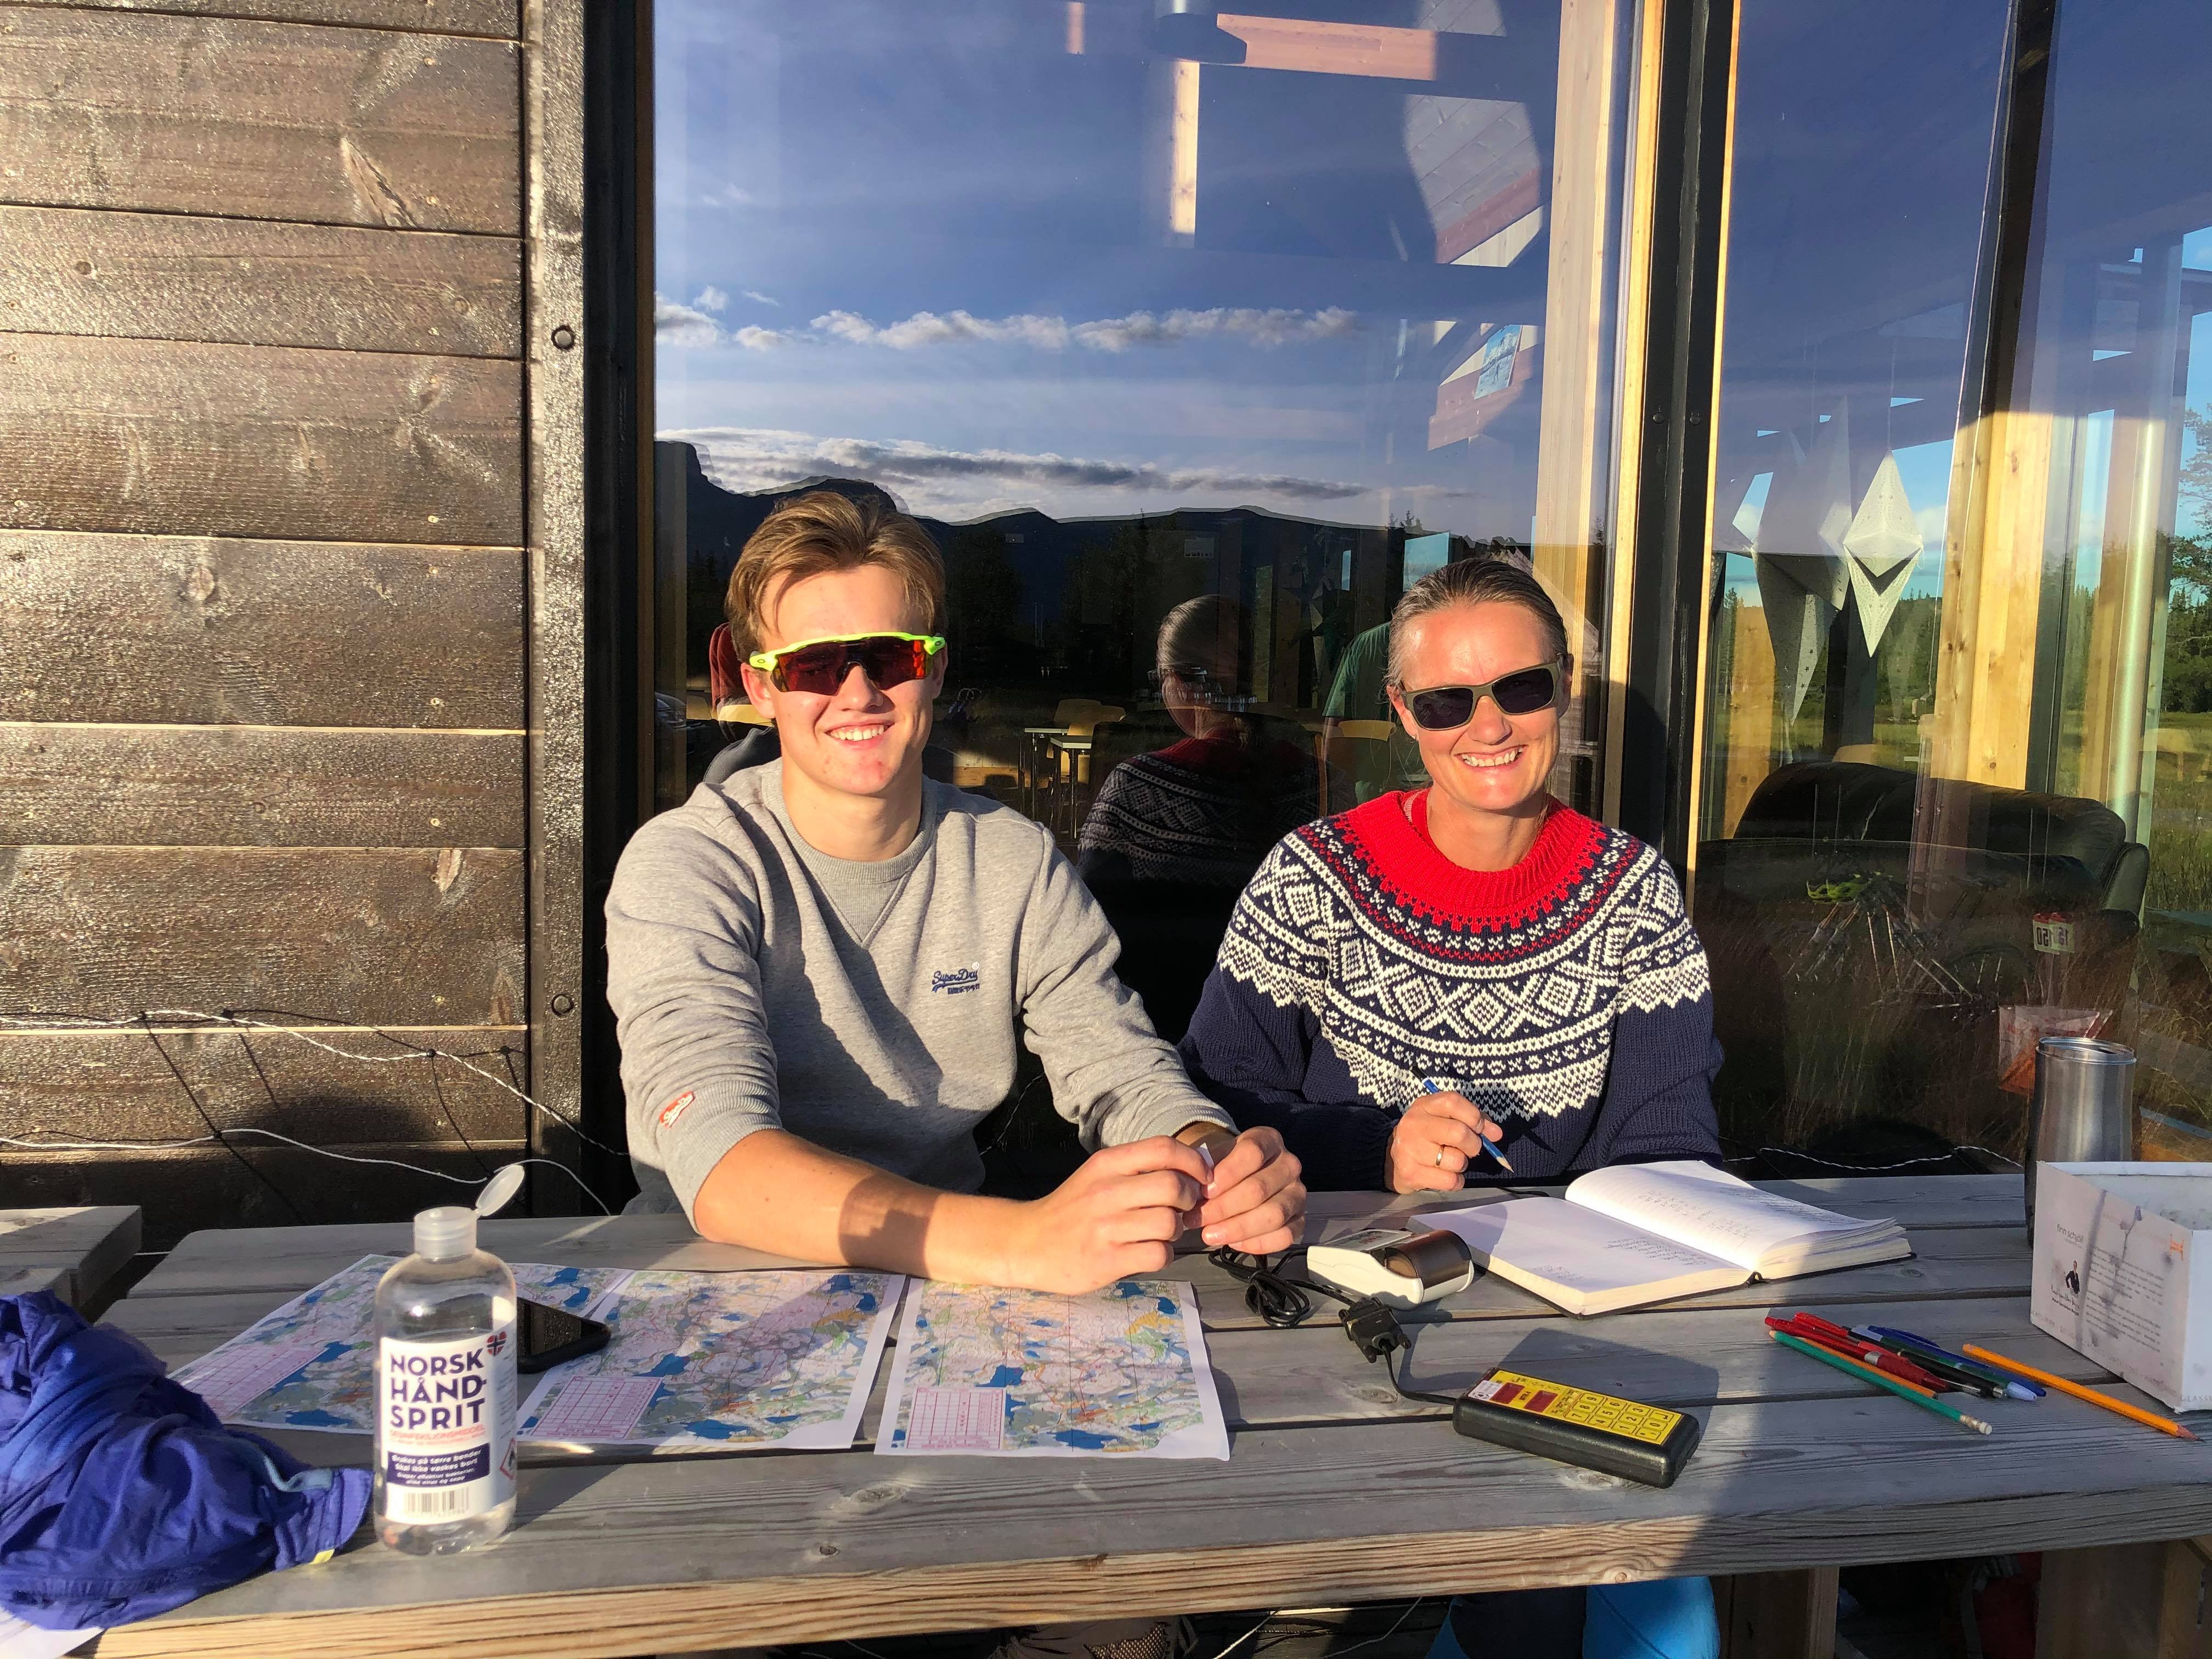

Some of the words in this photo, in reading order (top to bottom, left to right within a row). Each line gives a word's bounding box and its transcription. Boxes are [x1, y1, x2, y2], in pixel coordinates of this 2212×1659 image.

[390, 1347, 484, 1376] NORSK
[391, 1375, 487, 1403] HÅND-
[390, 1397, 486, 1430] SPRIT
